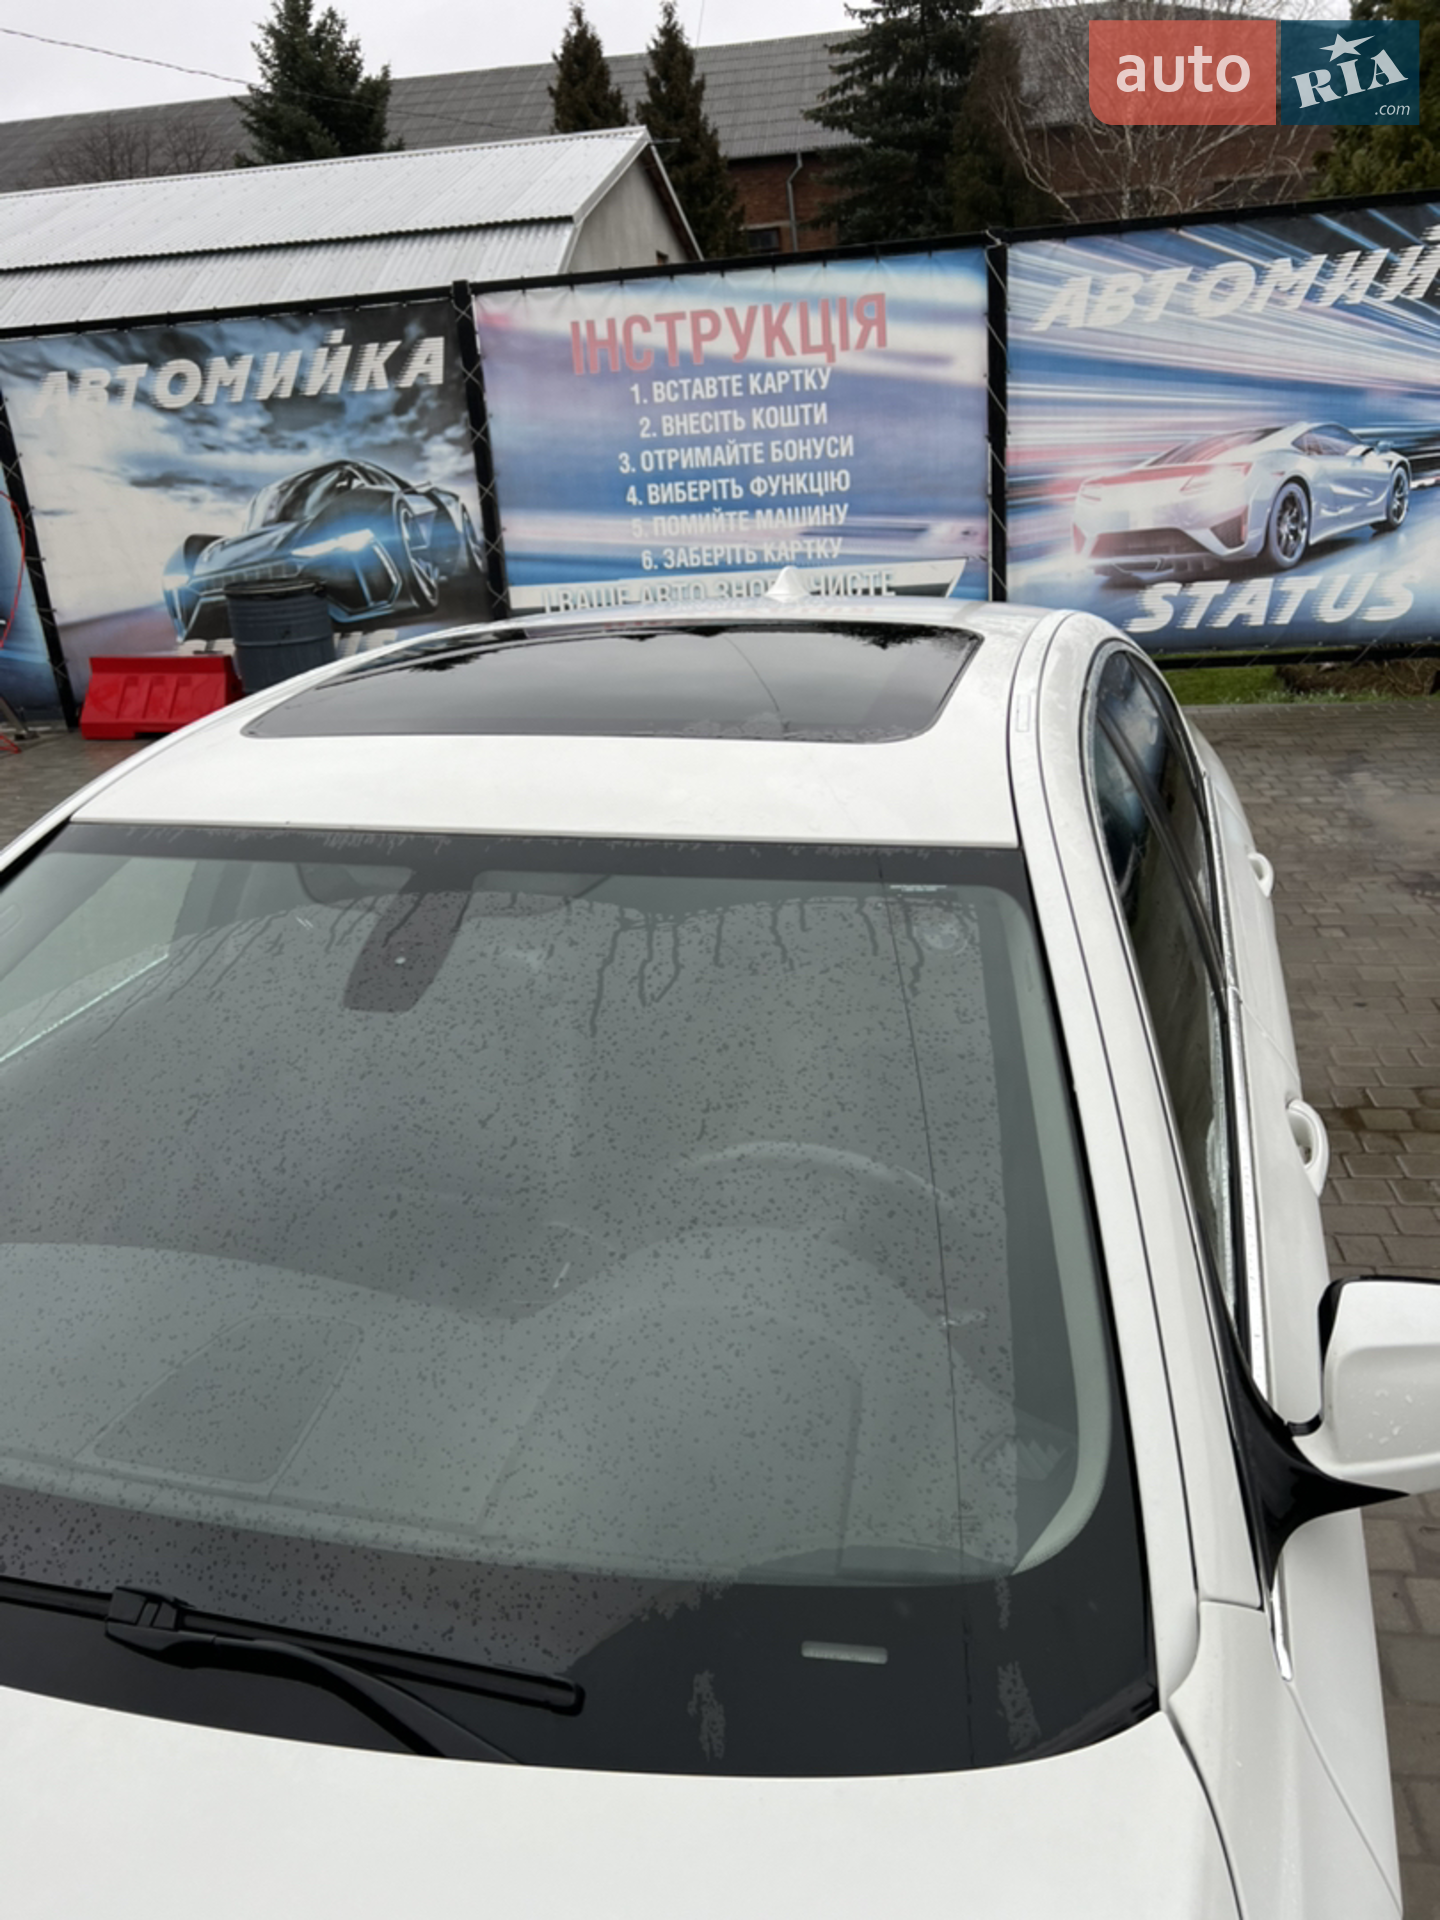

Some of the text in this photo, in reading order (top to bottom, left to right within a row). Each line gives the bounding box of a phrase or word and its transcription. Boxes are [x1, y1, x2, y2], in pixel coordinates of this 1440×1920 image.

[570, 292, 887, 375] ІНСТРУКЦІЯ
[28, 328, 445, 419] АВТОМИЙКА
[630, 367, 832, 404] 1. ВСТАВТЕ КАРТКУ
[639, 402, 828, 438] 2. ВНЕСІТЬ КОШТИ
[618, 435, 855, 474] 3. ОТРИМАЙТЕ БОНУСИ
[626, 469, 851, 506] 4. ВИБЕРІТЬ ФУНКЦІЮ
[632, 503, 849, 538] 5. ПОМИЙТЕ МАШИНУ
[641, 537, 843, 570] 6. ЗАБЕРІТЬ КАРТКУ
[558, 586, 630, 612] ВАШЕ
[640, 580, 706, 604] АВТО
[810, 571, 897, 597] ЧИСТЕ
[1122, 572, 1416, 634] STATUS
